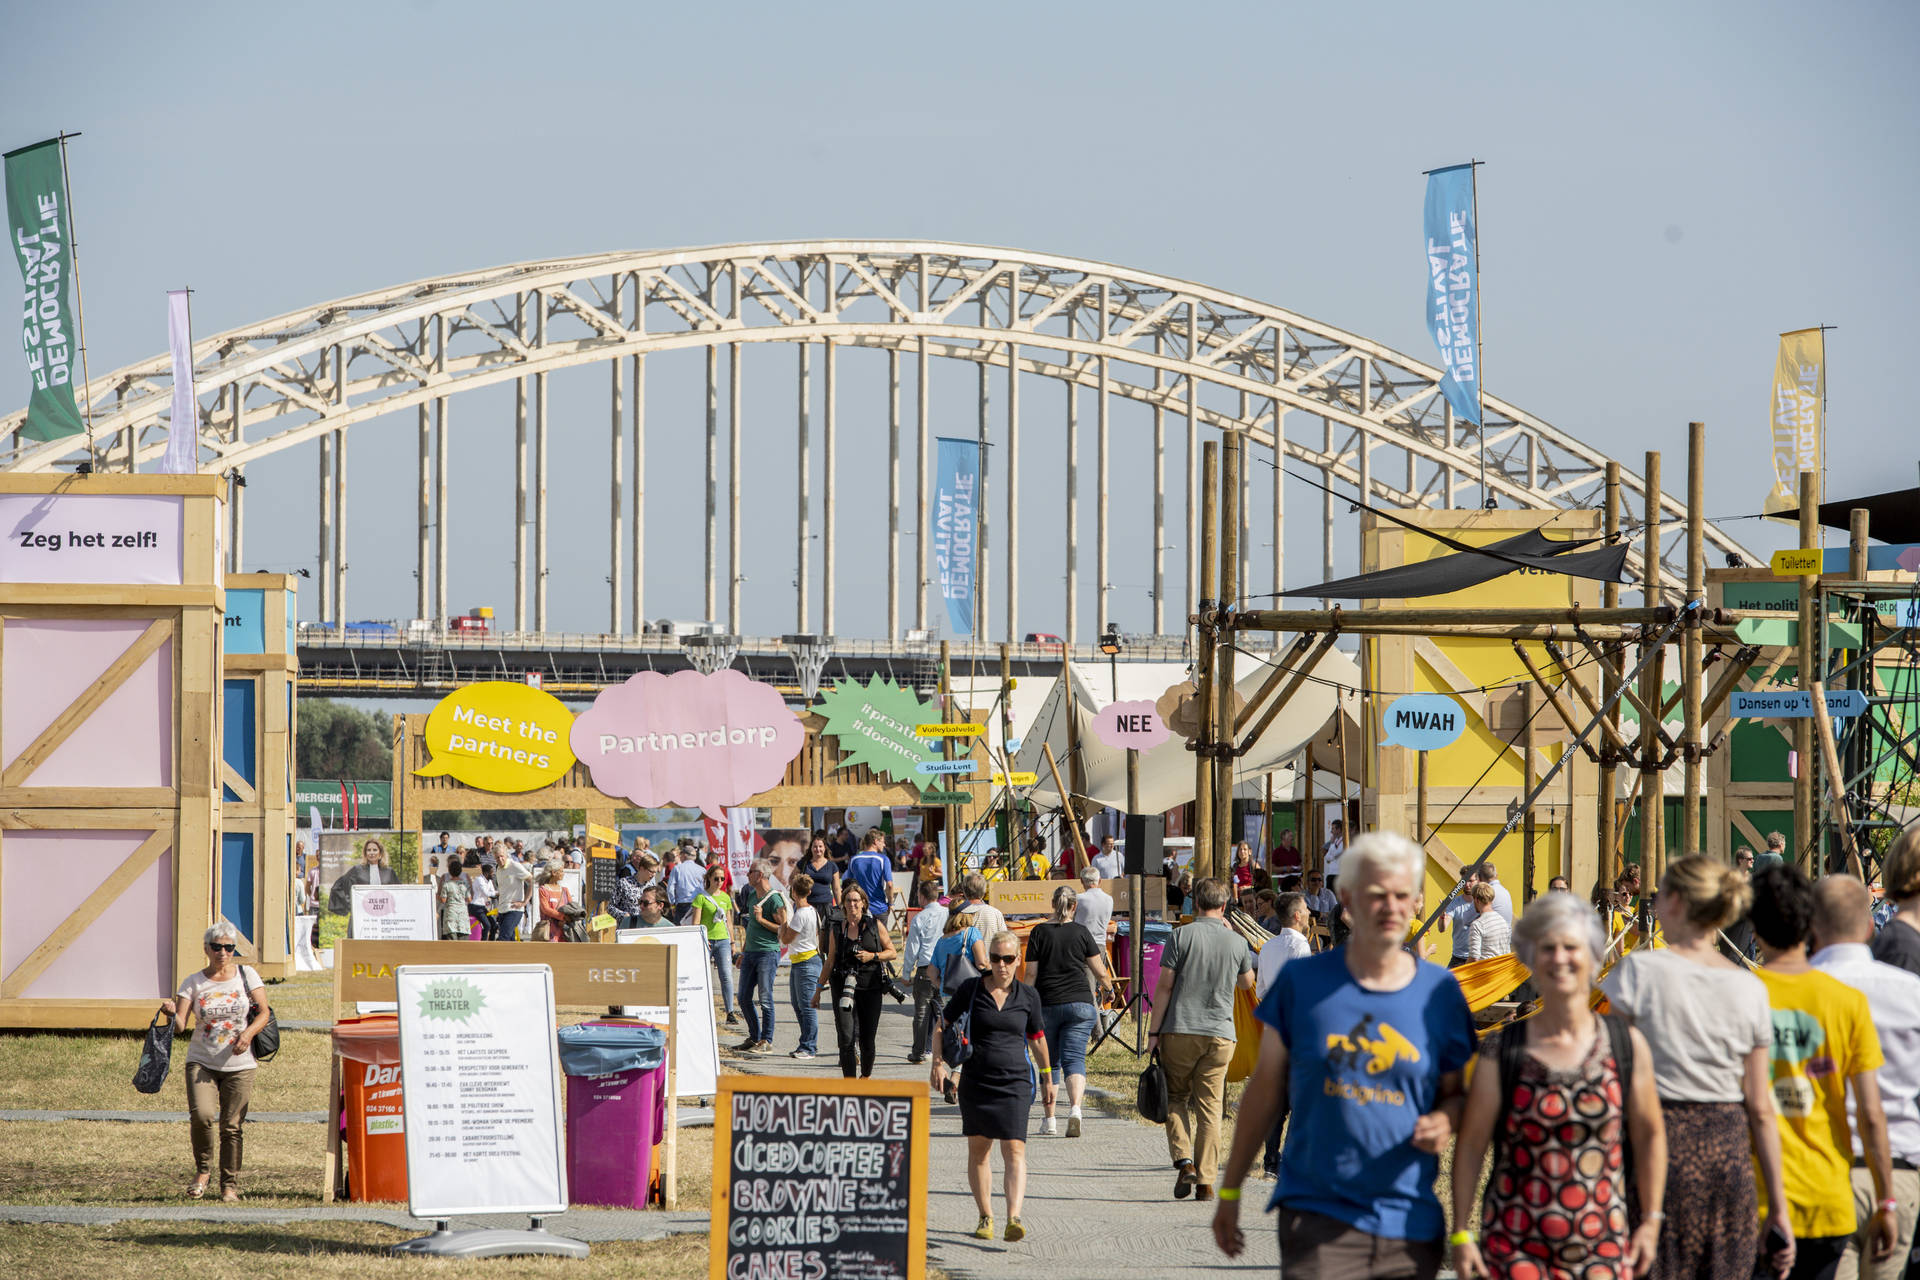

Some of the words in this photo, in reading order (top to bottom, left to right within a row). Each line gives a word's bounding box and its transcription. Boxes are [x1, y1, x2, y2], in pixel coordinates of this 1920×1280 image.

[20, 532, 61, 551] Zeg
[68, 530, 105, 548] het
[111, 531, 157, 548] zelf!
[1781, 556, 1815, 569] Toiletten
[1739, 697, 1780, 709] Dansen
[1783, 699, 1799, 711] op
[452, 705, 512, 735] Meet
[519, 721, 558, 744] the
[922, 726, 976, 734] Volleybalveld
[1116, 713, 1152, 733] NEE
[1395, 710, 1455, 731] MWAH
[599, 724, 778, 756] Partnerdorp
[448, 732, 551, 769] partners
[1000, 892, 1044, 902] PLASTIC
[588, 967, 640, 984] REST
[433, 988, 463, 999] BOSCO
[428, 1000, 470, 1011] THEATER
[732, 1093, 911, 1140] HOMEMADE
[733, 1173, 858, 1213] BROWNIE
[729, 1211, 841, 1247] COOKIES
